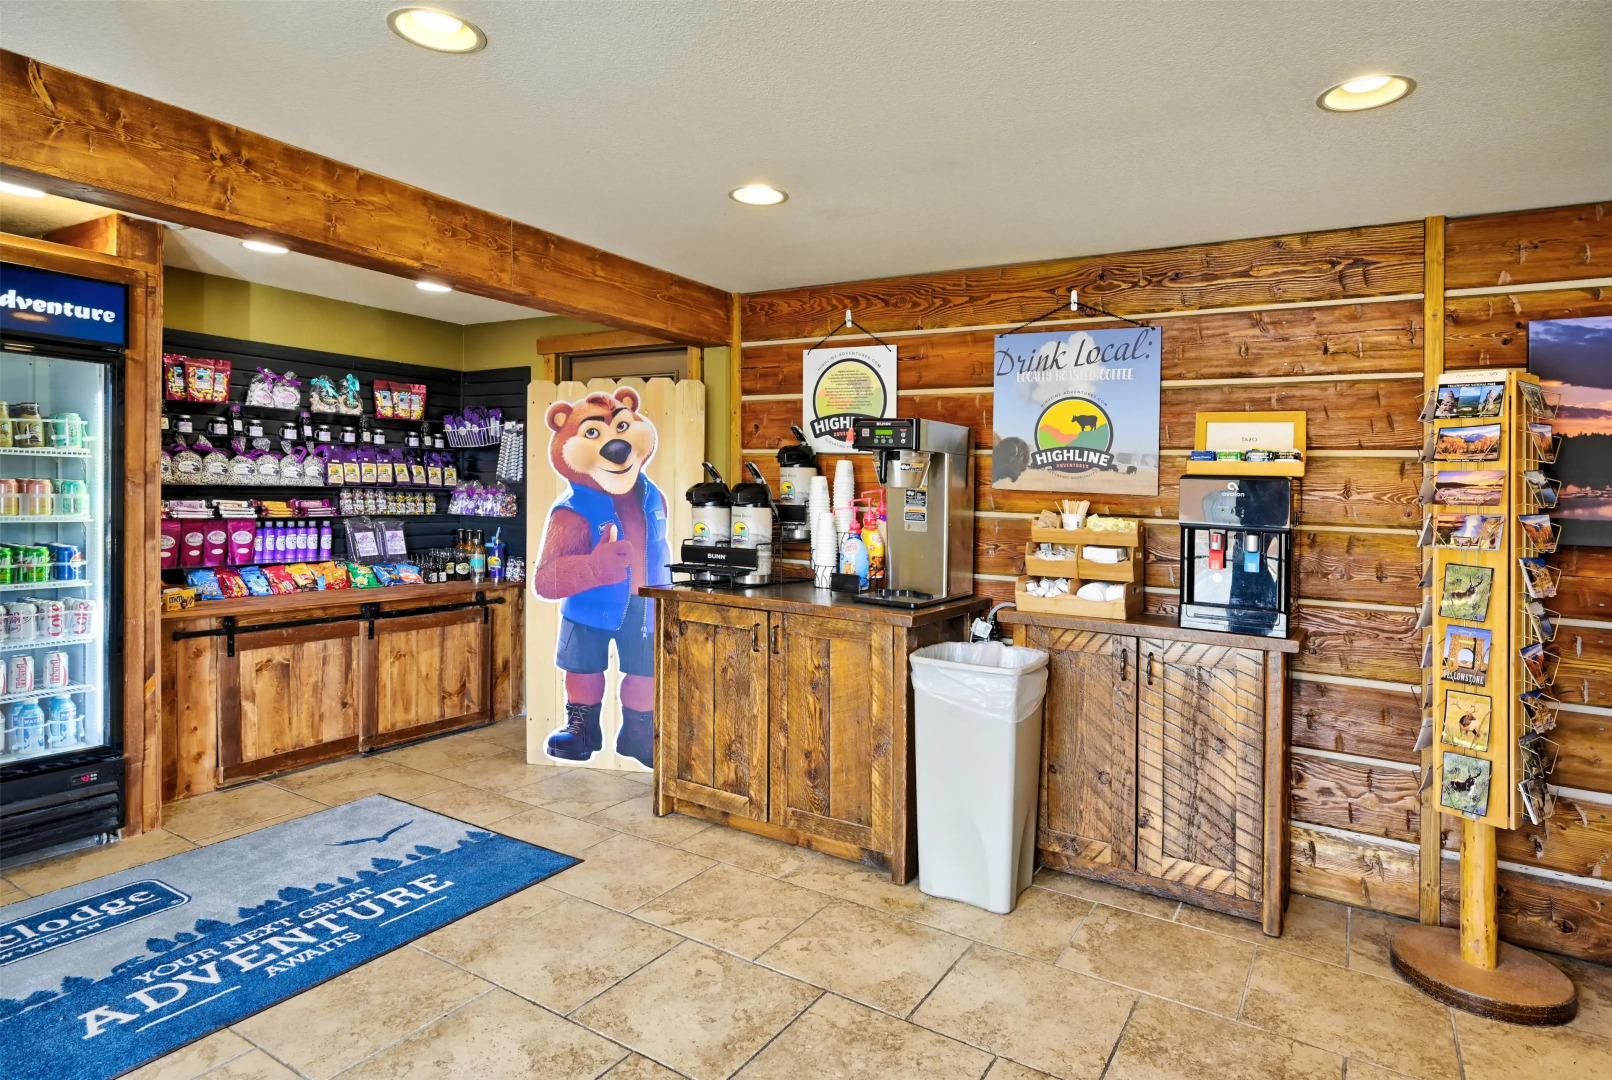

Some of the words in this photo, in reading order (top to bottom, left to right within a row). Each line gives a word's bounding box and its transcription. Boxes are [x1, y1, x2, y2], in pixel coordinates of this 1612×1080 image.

[0, 289, 116, 323] dventure
[995, 341, 1067, 377] Drink
[1074, 328, 1153, 367] Local:
[1100, 368, 1134, 381] COFFEE
[1035, 449, 1110, 467] HIGHLINE
[707, 552, 726, 560] BUNN
[0, 922, 101, 960] WYNDHAM
[132, 948, 221, 984] YOUR
[220, 917, 294, 950] NEXT
[298, 886, 375, 919] GREAT
[77, 873, 454, 1041] ADVENTURE
[264, 931, 361, 978] AWAITS
